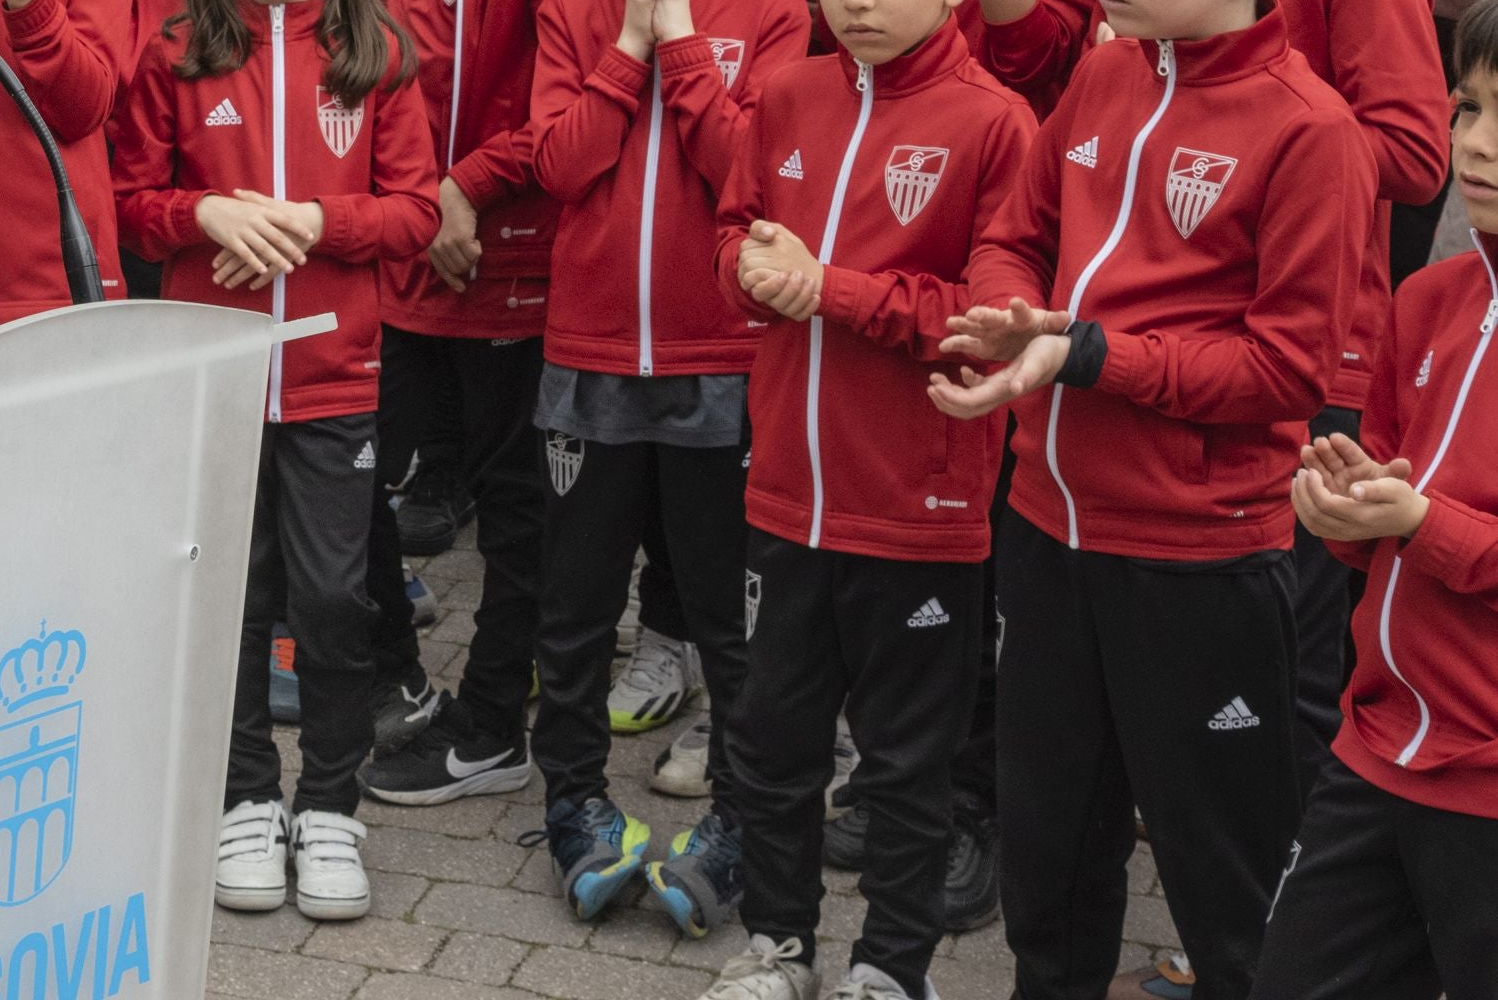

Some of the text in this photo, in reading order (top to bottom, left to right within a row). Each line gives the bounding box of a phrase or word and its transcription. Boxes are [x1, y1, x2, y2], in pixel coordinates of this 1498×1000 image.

[205, 116, 242, 126] adidas
[1066, 150, 1097, 169] adidas
[778, 167, 804, 180] adidas
[907, 613, 950, 627] adidas
[1208, 716, 1260, 730] adidas
